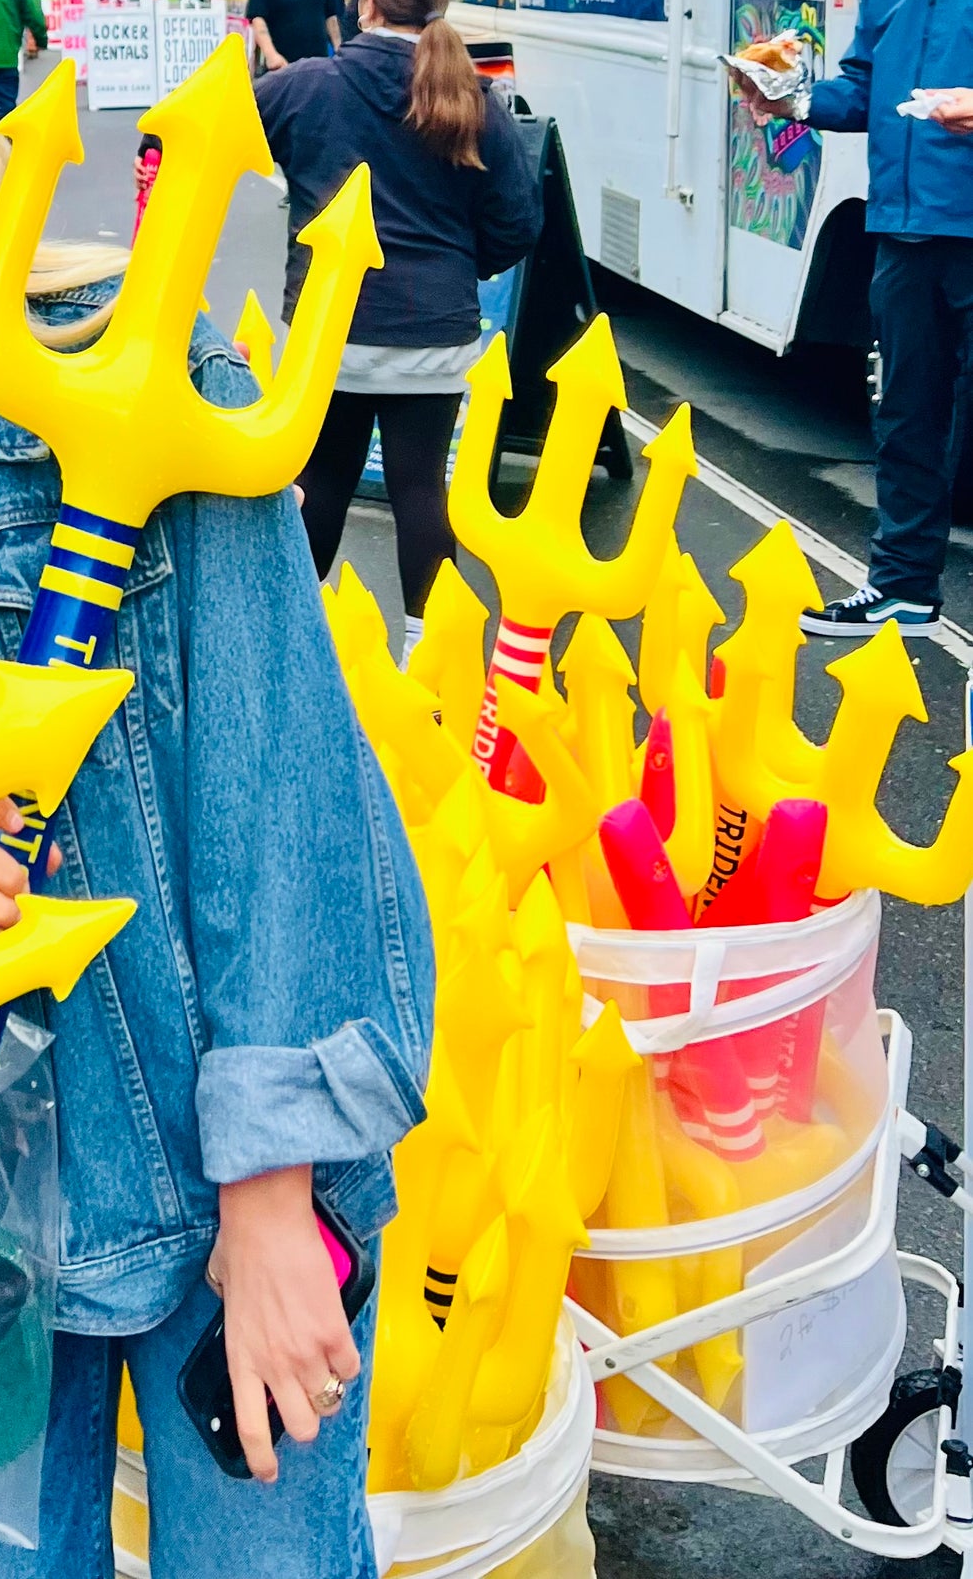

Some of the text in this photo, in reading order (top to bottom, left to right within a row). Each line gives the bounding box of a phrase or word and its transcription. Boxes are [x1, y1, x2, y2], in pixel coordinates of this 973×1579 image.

[93, 24, 148, 40] LOCKER
[163, 17, 220, 37] OFFICIAL
[93, 44, 149, 60] RENTALS
